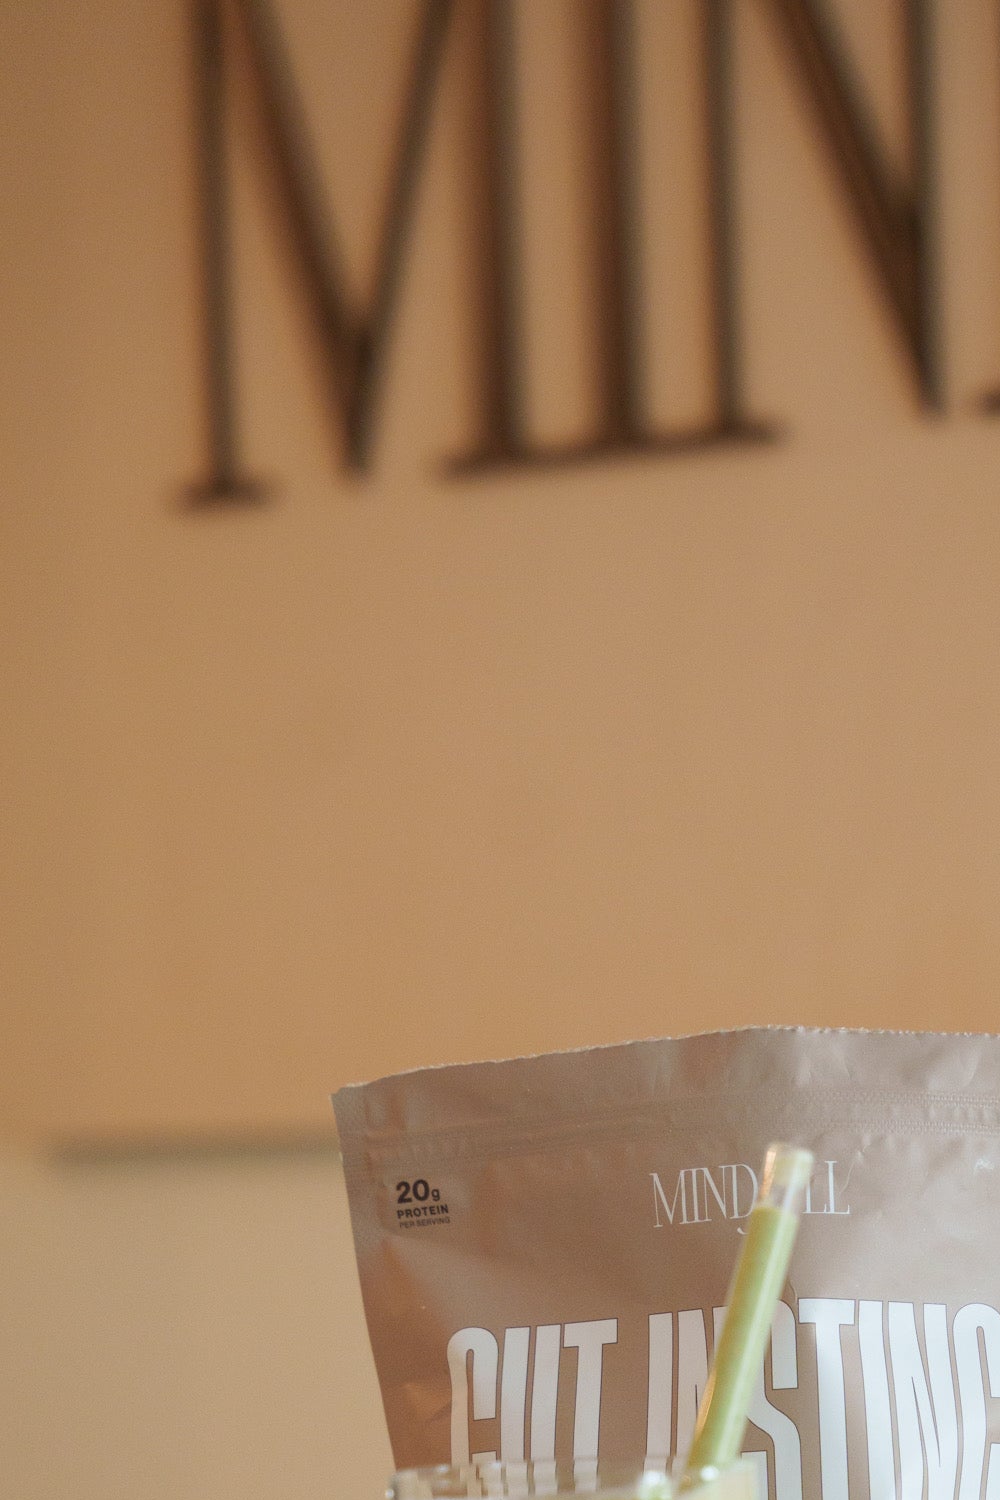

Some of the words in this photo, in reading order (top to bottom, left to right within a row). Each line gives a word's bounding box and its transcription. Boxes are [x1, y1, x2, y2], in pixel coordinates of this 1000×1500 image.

[396, 1179, 440, 1204] 20g
[649, 1160, 850, 1235] MINDLL
[396, 1203, 449, 1219] PROTEIN
